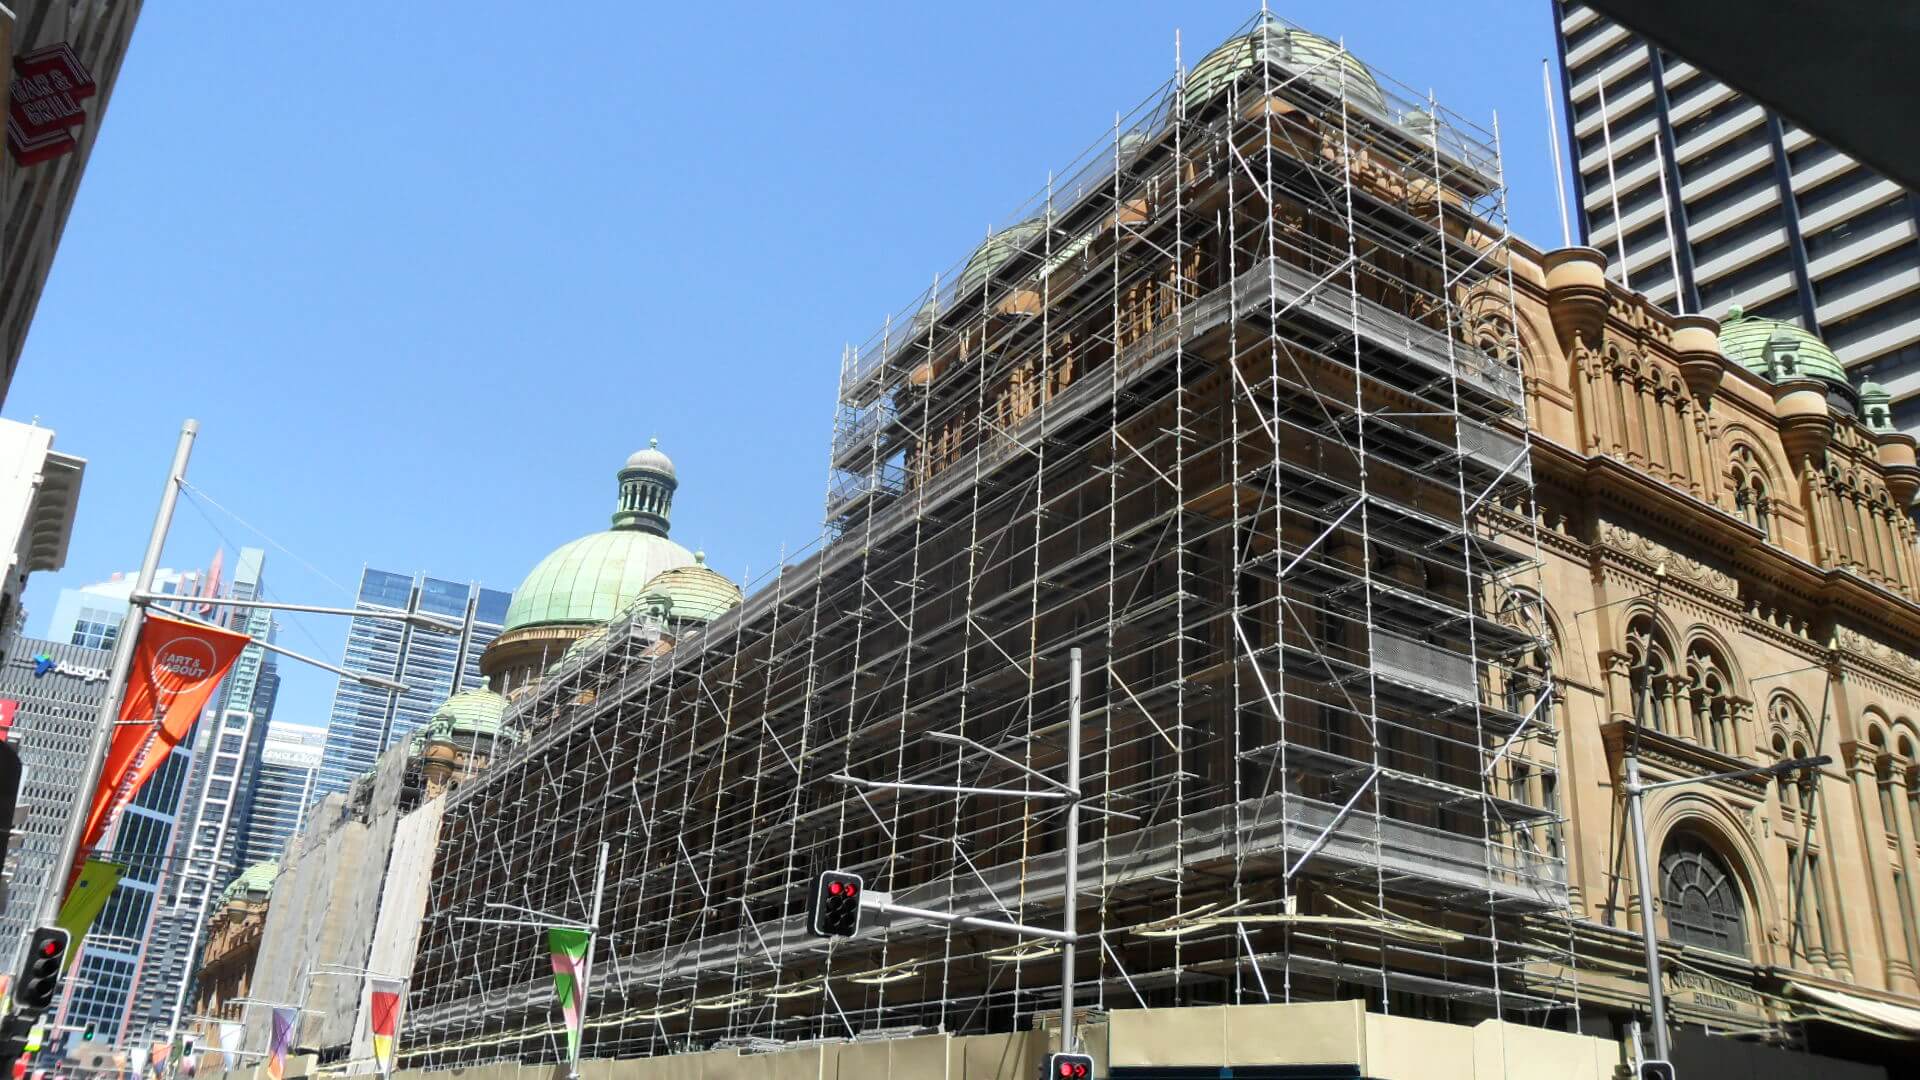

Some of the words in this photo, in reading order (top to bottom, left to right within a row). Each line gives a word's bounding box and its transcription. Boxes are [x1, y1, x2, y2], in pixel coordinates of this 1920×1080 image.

[23, 92, 80, 125] GRILL
[166, 653, 193, 666] ART
[54, 659, 111, 682] Ausgri
[163, 662, 207, 678] ABOUT
